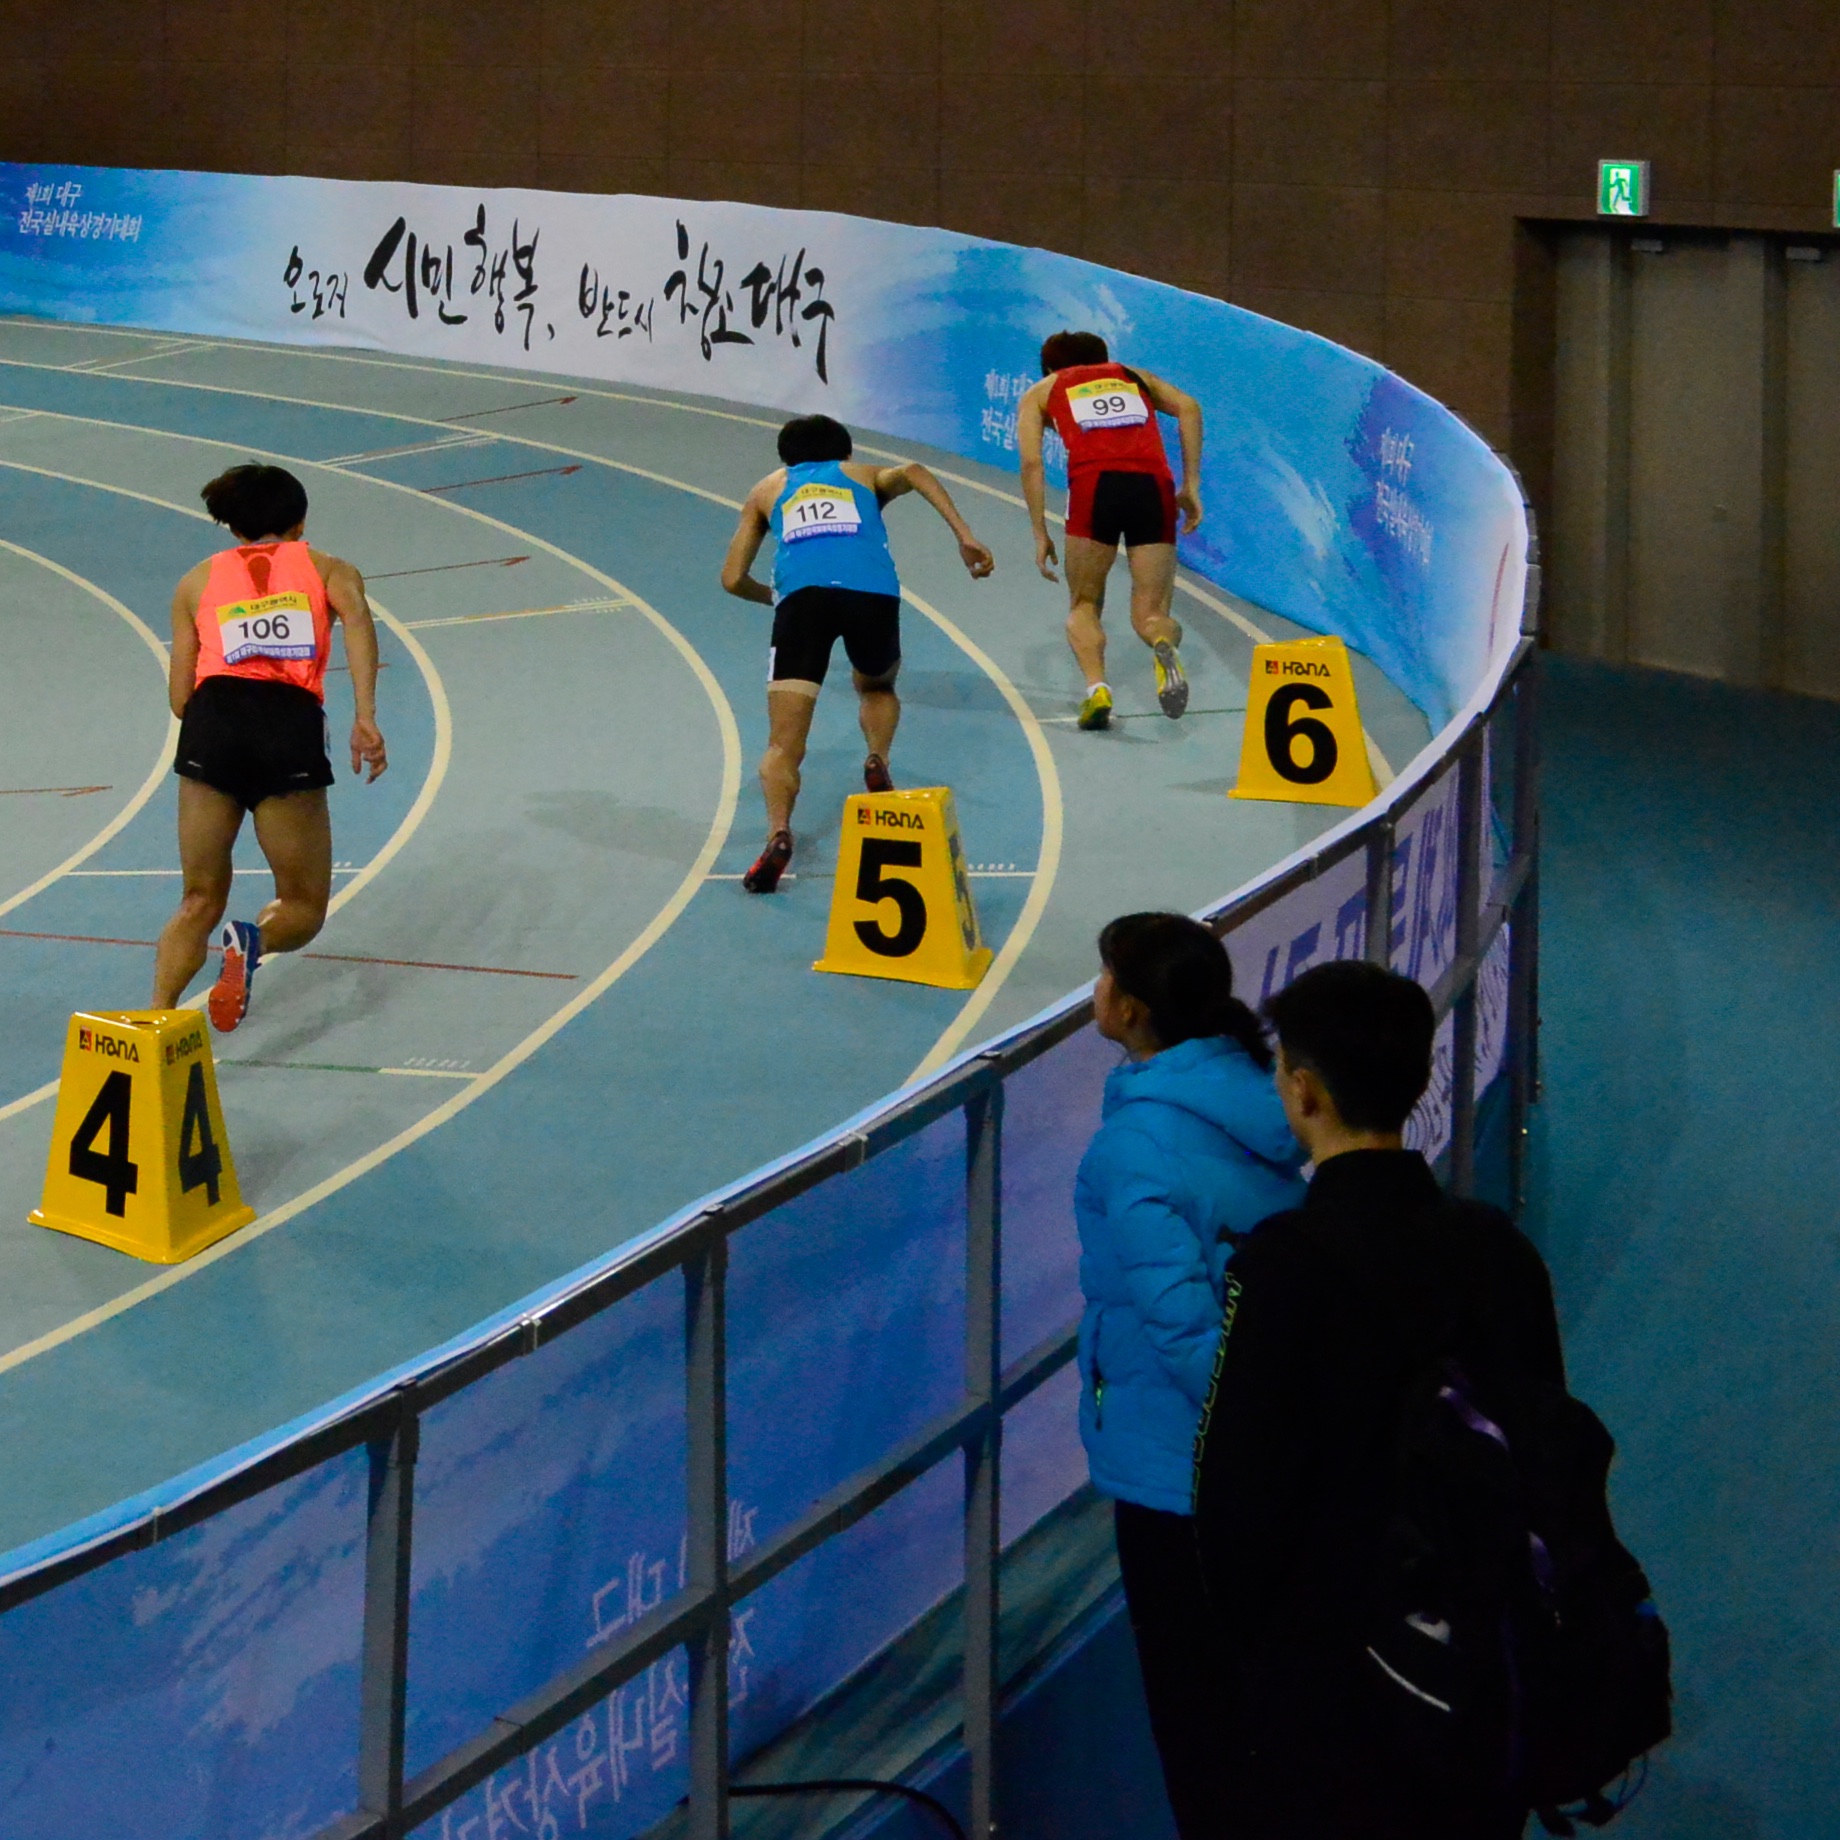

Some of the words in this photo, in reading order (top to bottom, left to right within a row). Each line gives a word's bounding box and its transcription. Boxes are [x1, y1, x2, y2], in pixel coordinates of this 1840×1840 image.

[19, 208, 143, 244] 전국실내육상경기대회
[25, 181, 55, 206] 제1회
[56, 181, 83, 208] 대구
[283, 245, 349, 321] 오로지
[578, 261, 655, 344] 반드시
[1092, 395, 1126, 416] 99
[796, 501, 837, 523] 112
[238, 614, 290, 640] 106
[1264, 682, 1338, 785] 6
[853, 837, 927, 958] 5
[68, 1069, 139, 1218] 4
[178, 1061, 223, 1207] 4
